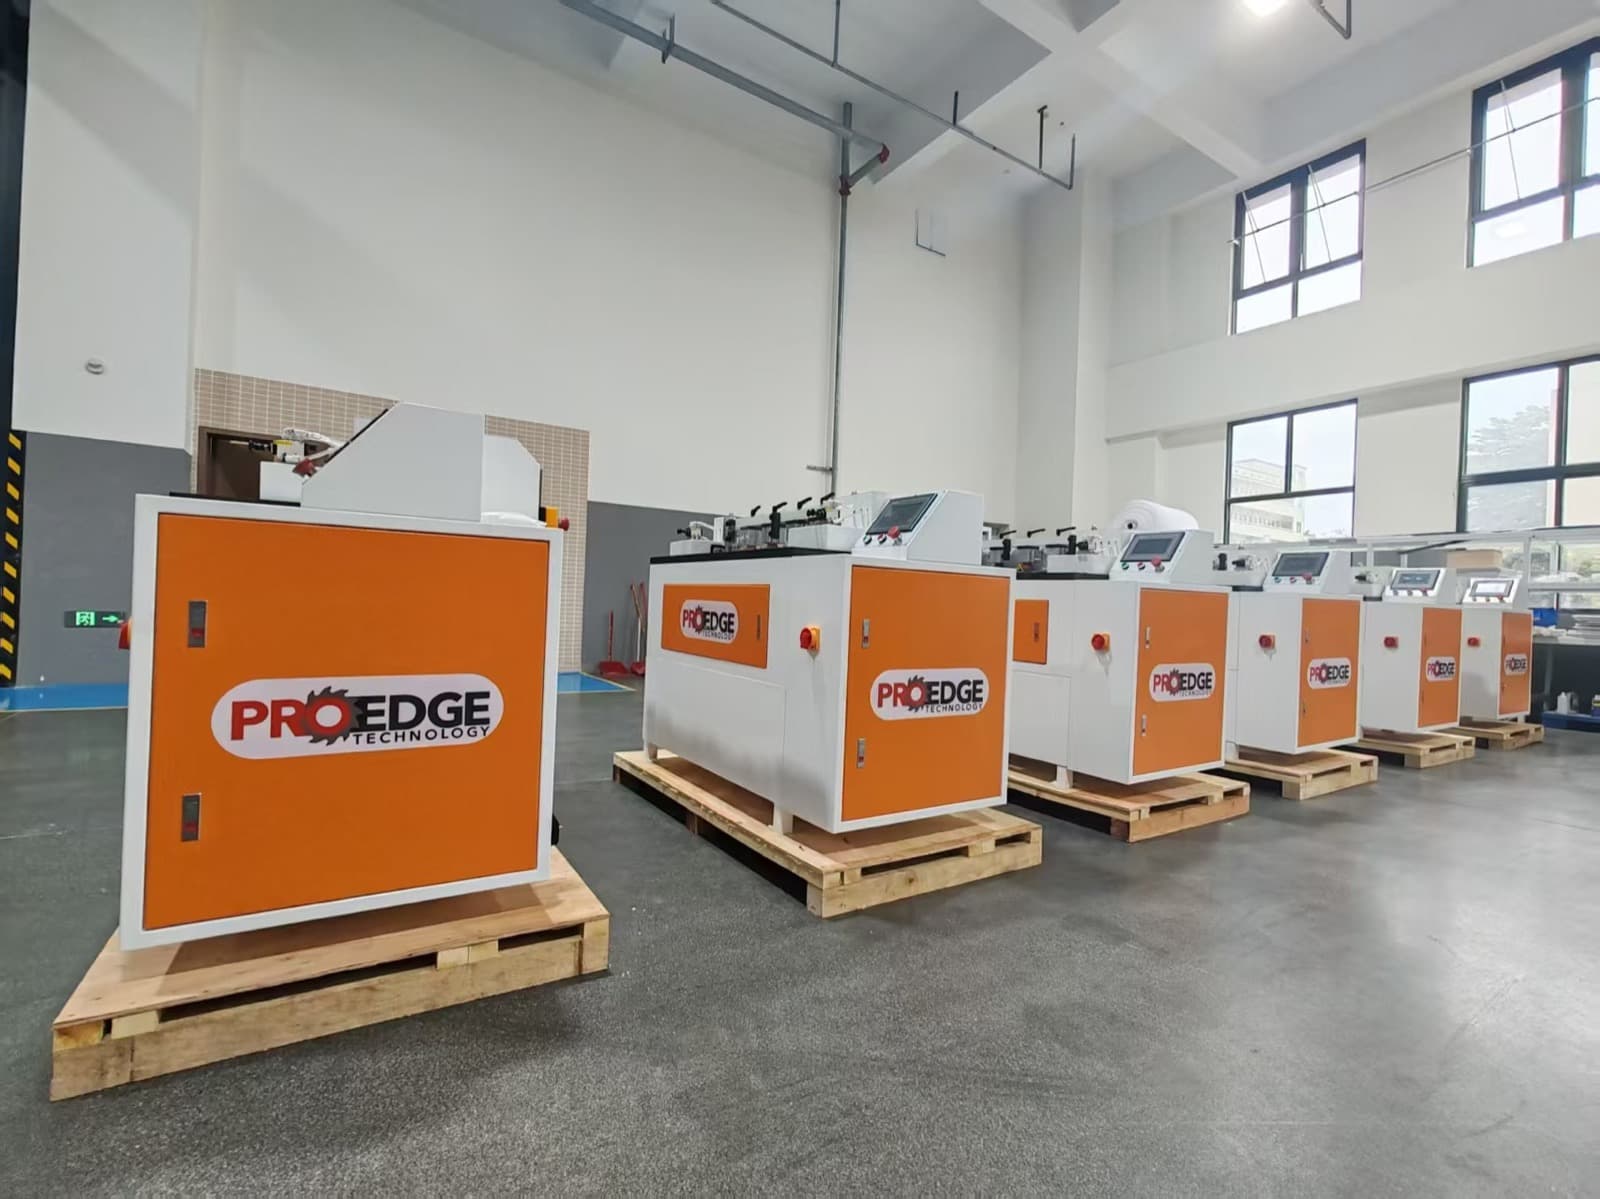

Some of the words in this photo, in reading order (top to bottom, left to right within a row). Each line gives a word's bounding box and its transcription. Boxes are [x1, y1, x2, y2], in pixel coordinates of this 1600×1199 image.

[682, 607, 735, 634] PROEDGE
[877, 679, 984, 708] PROEDGE
[1153, 671, 1213, 693] PROEDGE
[230, 690, 491, 741] PROEDGE
[925, 703, 983, 713] TECHNOLOGY
[352, 726, 491, 745] TECHNOLOGY
